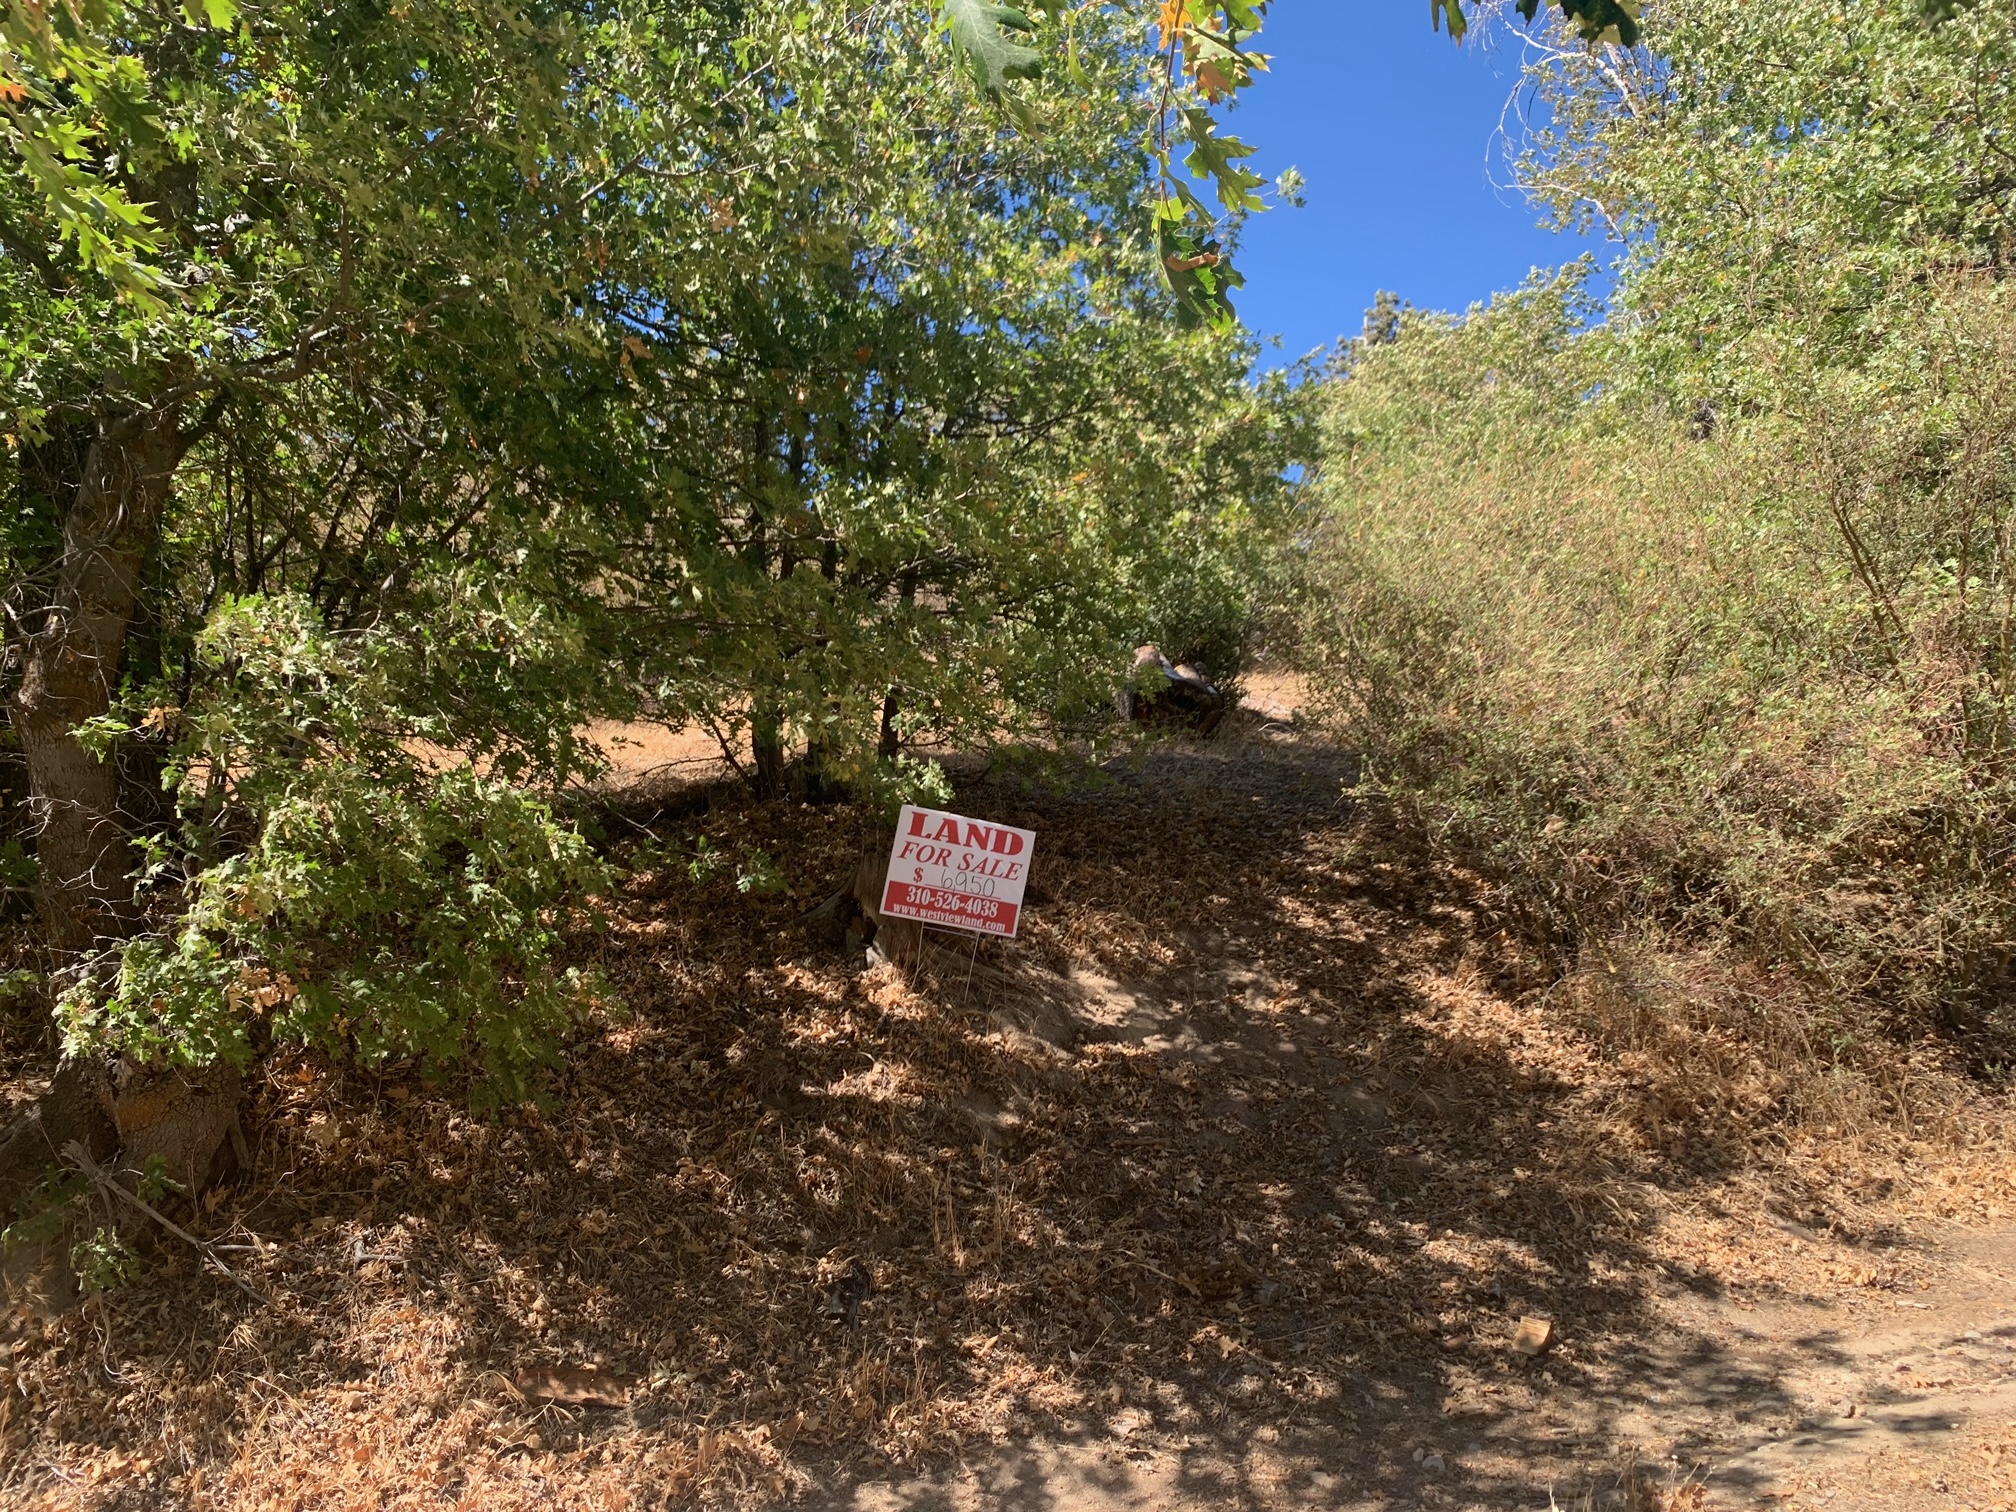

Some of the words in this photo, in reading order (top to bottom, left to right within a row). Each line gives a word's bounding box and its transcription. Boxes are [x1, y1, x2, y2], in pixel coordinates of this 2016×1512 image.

[907, 811, 1024, 856] LAND
[897, 841, 952, 867] FOR
[957, 852, 1023, 881] SALE
[893, 902, 1006, 933] www.westviewland.com
[906, 885, 999, 918] 310-526-4038
